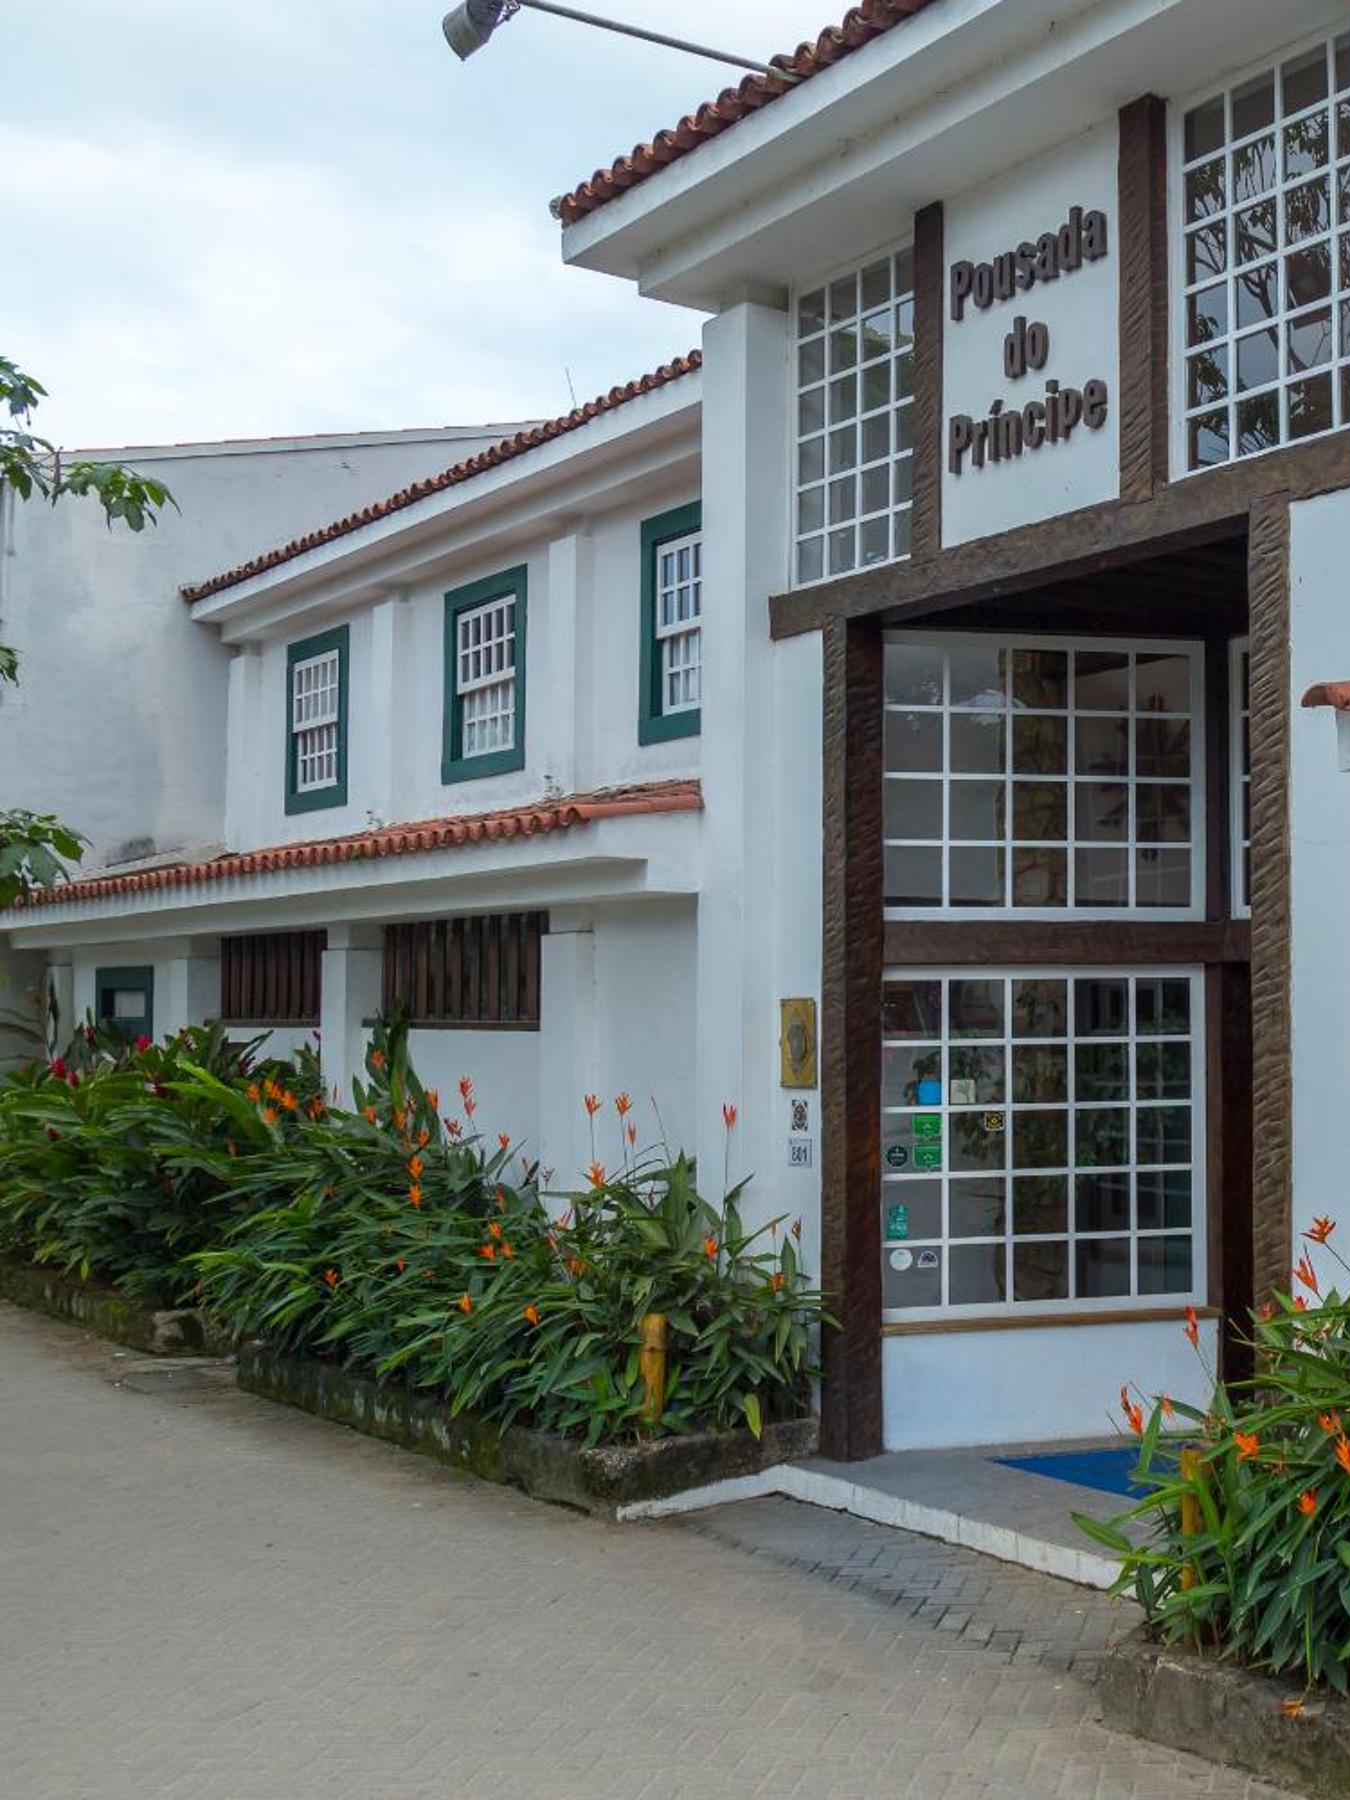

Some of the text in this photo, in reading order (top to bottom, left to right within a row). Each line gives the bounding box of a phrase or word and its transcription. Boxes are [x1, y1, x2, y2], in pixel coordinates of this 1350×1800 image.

[950, 205, 1108, 321] Pousada
[1004, 316, 1050, 379] do
[949, 379, 1108, 474] Príncipe
